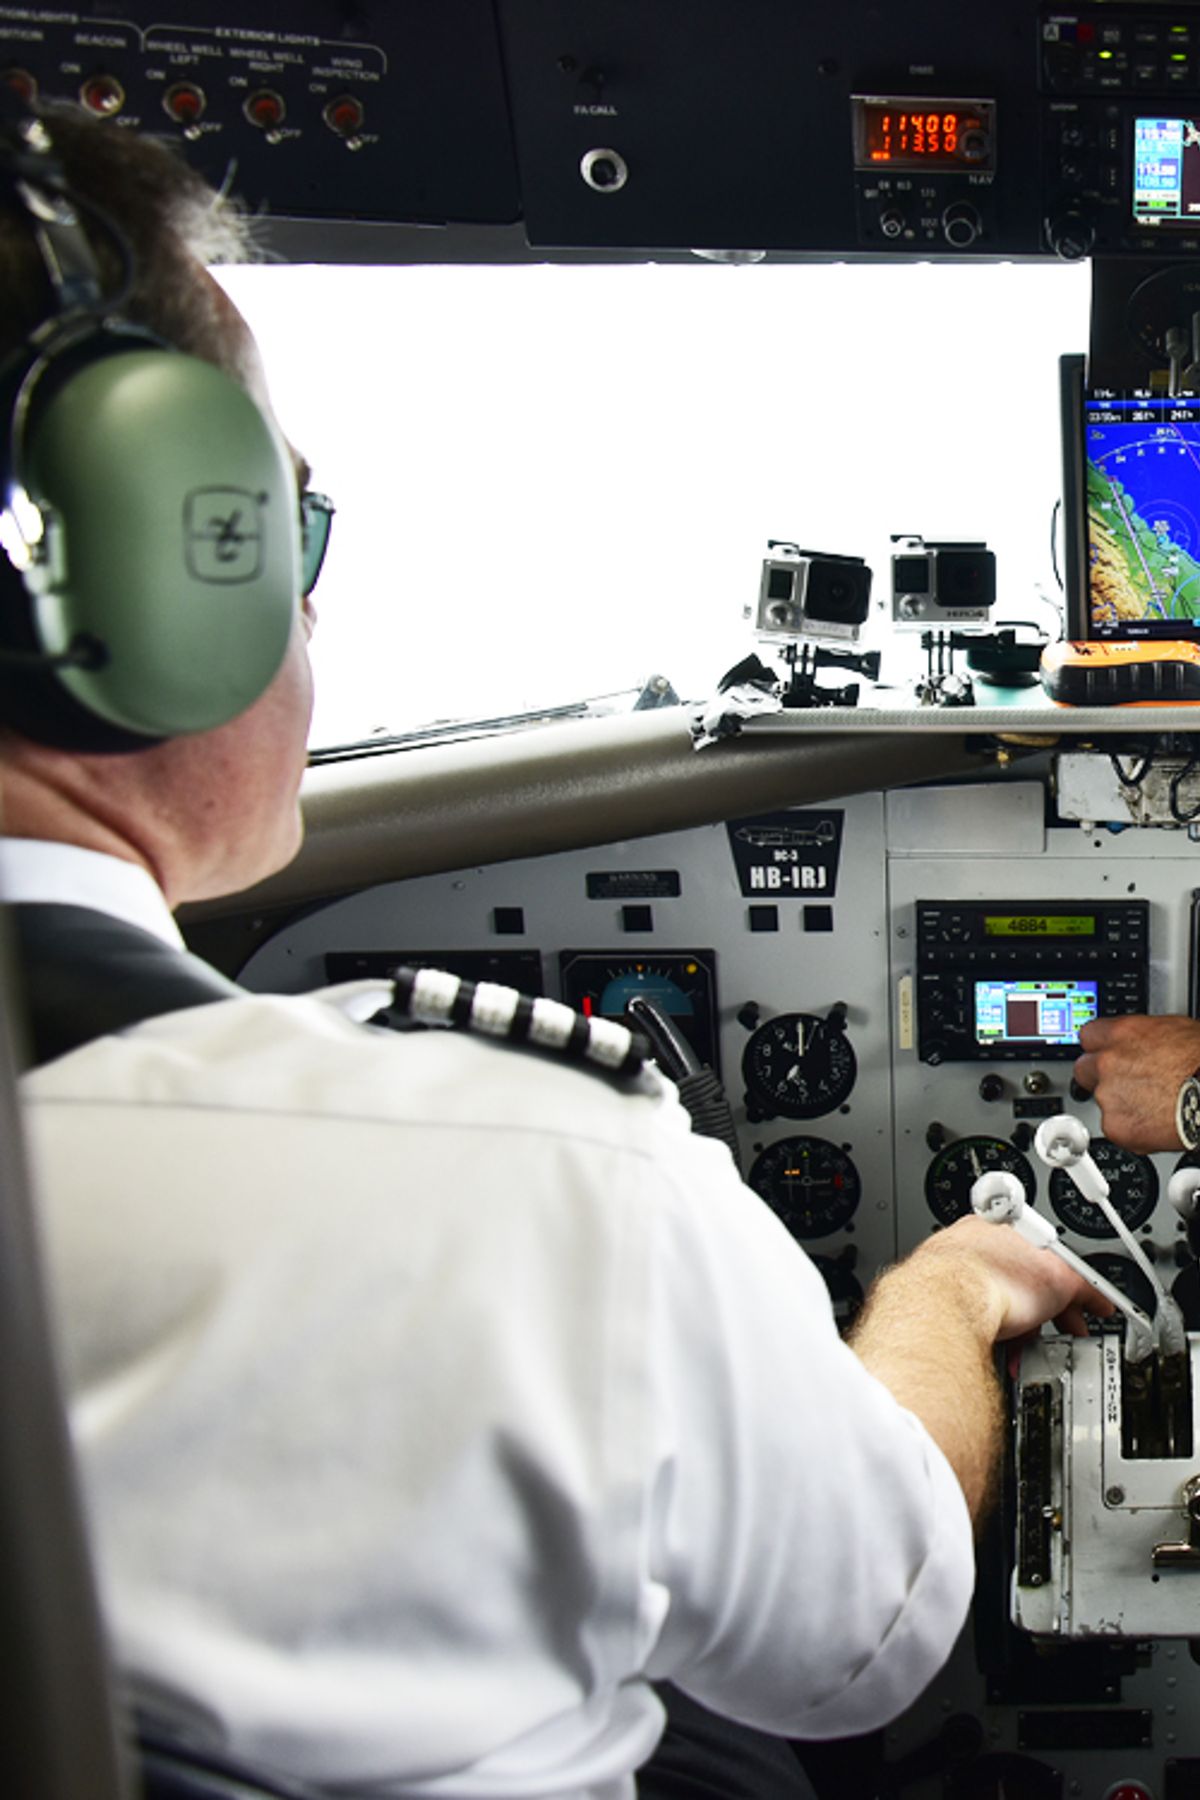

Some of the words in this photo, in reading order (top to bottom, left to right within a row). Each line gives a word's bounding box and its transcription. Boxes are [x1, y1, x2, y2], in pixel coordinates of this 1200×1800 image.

[31, 9, 80, 24] LIGHTS
[74, 32, 127, 48] BEACON
[214, 26, 277, 42] EXTERIOR
[278, 32, 321, 47] LIGHTS
[147, 40, 188, 54] WHEEL
[190, 44, 224, 57] WELL
[169, 54, 200, 65] LEFT
[229, 47, 270, 61] WHEEL
[272, 52, 304, 65] WELL
[60, 62, 81, 74] ON
[249, 61, 285, 73] RIGHT
[331, 57, 363, 69] WING
[145, 68, 167, 81] ON
[311, 66, 381, 82] INSPECTION
[228, 76, 248, 88] ON
[308, 82, 328, 94] ON
[589, 104, 619, 117] CALL
[115, 115, 142, 128] OFF
[199, 121, 224, 133] OFF
[279, 127, 303, 138] OFF
[773, 848, 799, 862] DC-3
[749, 864, 828, 890] HB-IRJ
